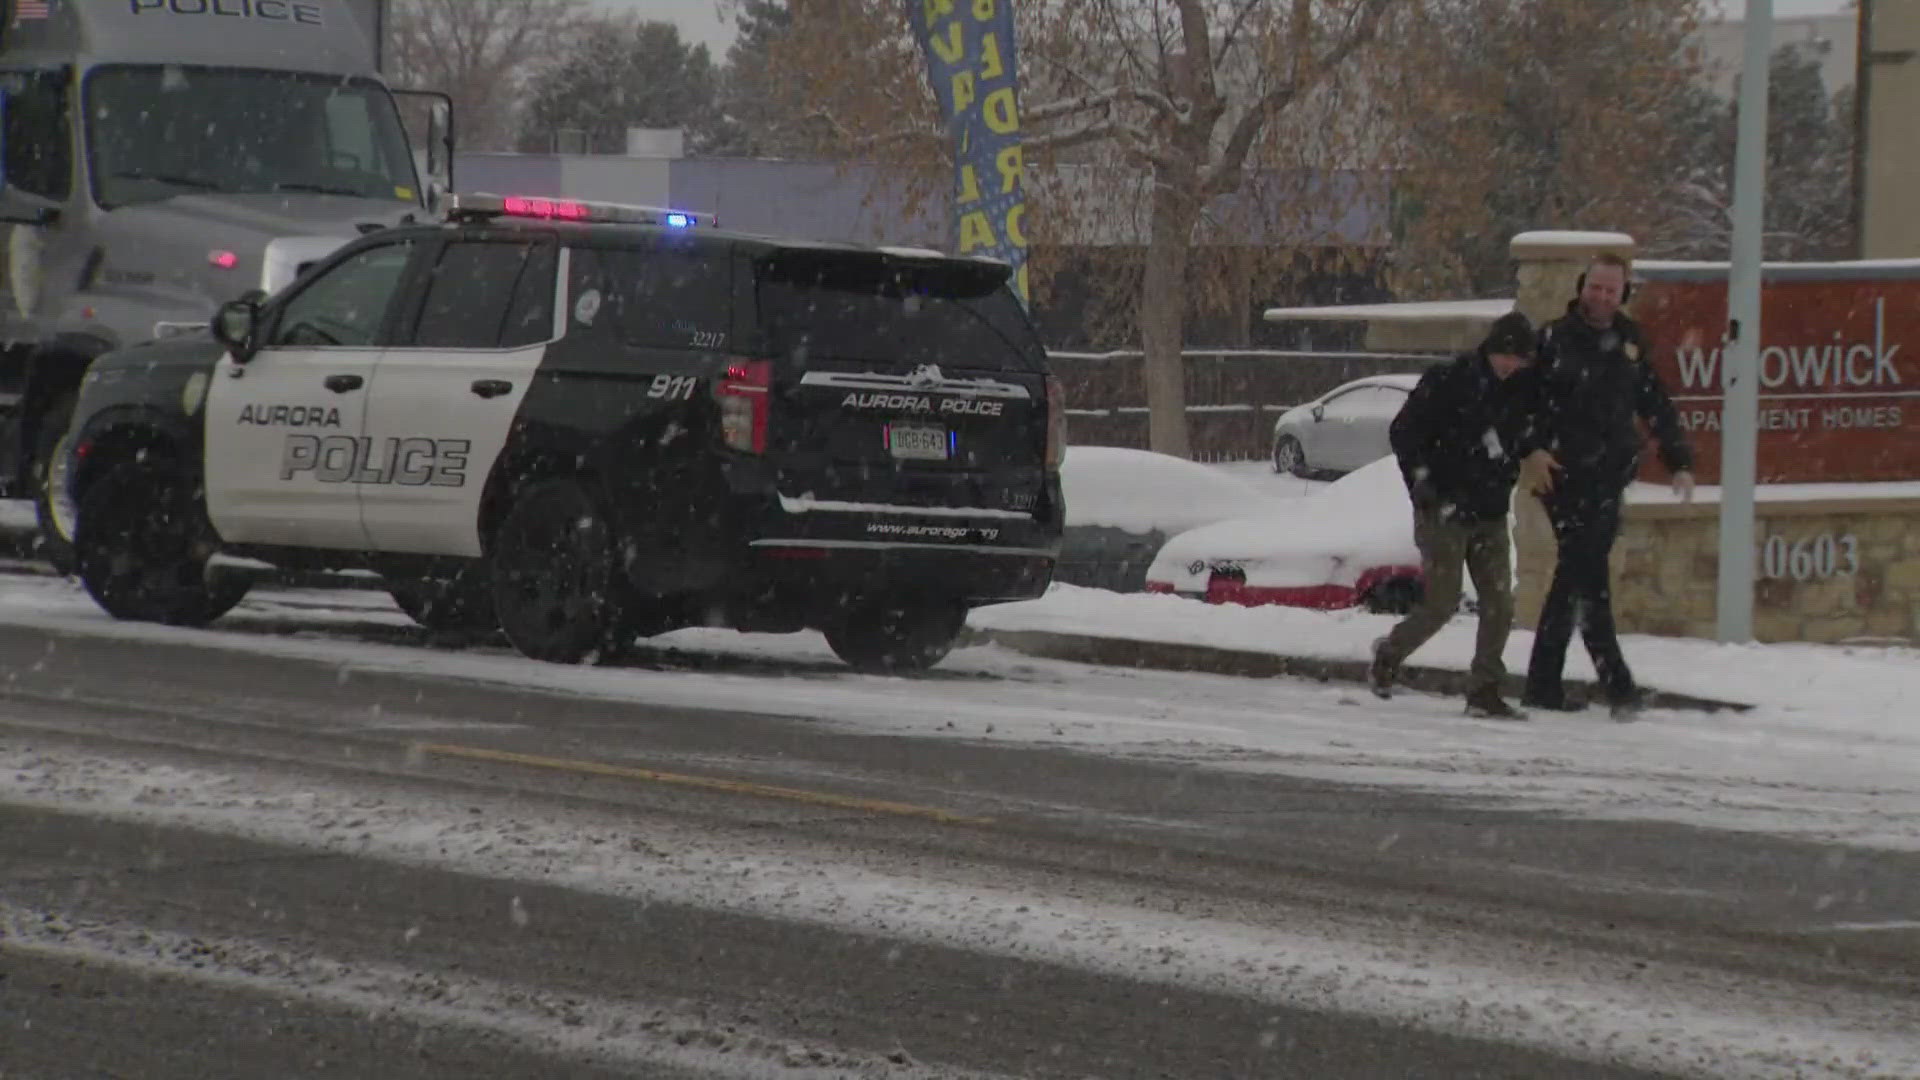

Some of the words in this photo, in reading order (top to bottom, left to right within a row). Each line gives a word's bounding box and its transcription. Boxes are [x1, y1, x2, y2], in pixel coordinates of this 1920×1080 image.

[130, 0, 322, 25] POLICE
[1676, 297, 1901, 388] wiowick
[647, 374, 697, 400] 911
[237, 404, 342, 428] AURORA
[842, 392, 931, 411] AURORA
[939, 399, 1003, 416] POLICE
[1823, 405, 1902, 430] HOMES
[279, 433, 472, 488] POLICE
[1754, 533, 1859, 580] 0603
